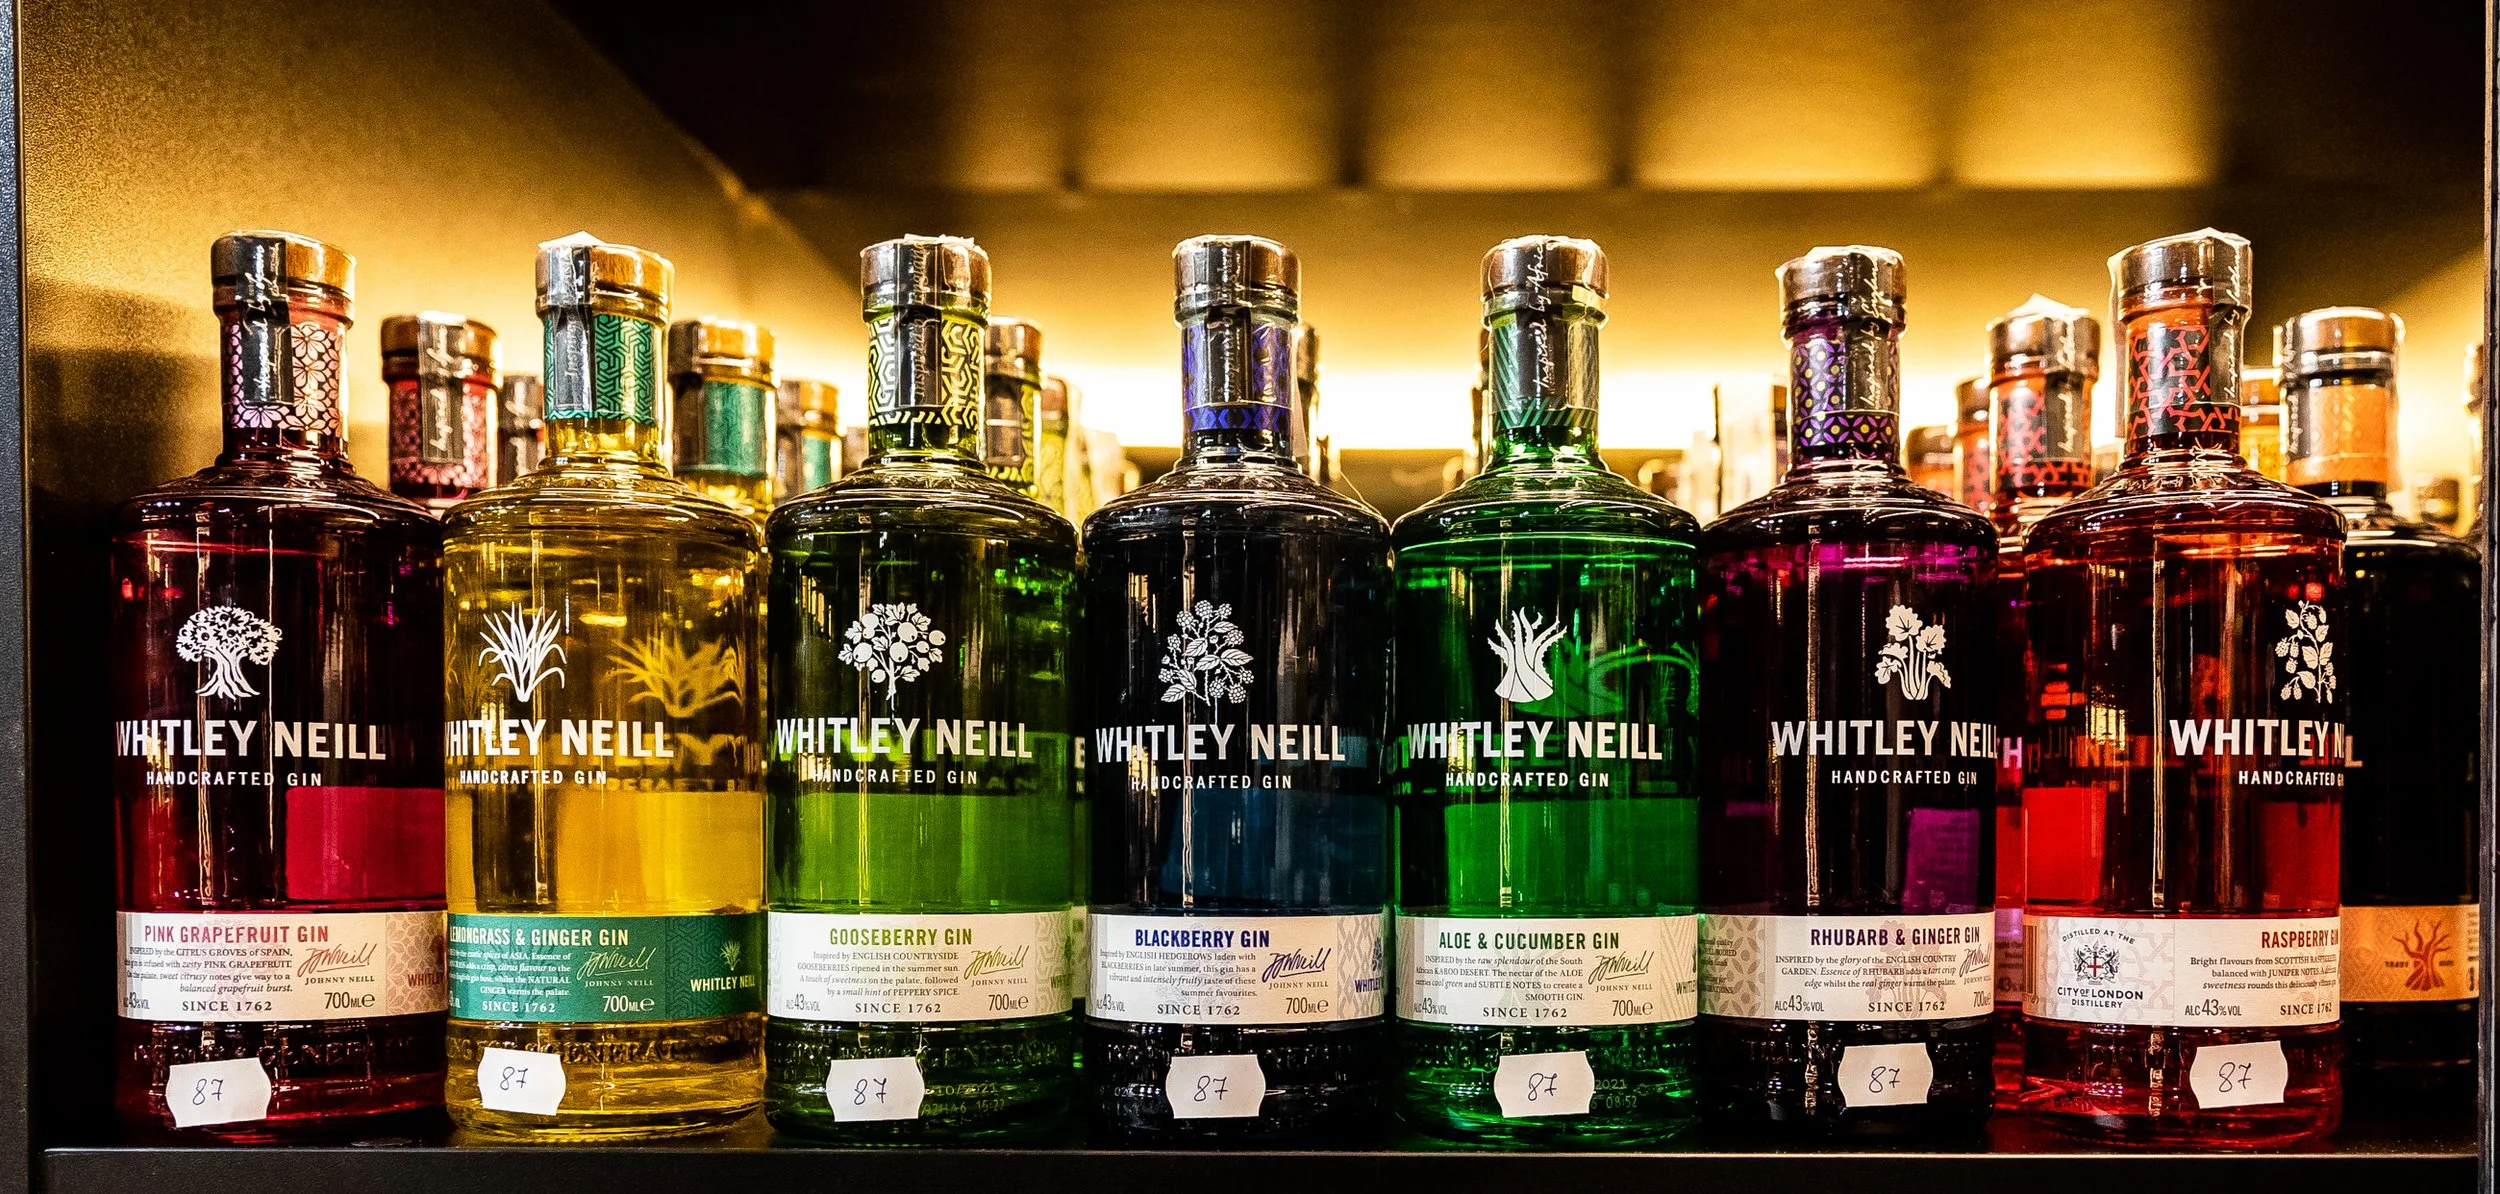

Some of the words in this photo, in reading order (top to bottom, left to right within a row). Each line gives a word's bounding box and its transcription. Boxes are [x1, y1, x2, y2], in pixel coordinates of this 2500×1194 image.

[1529, 295, 1551, 312] by
[1860, 321, 1880, 337] by
[1531, 319, 1554, 388] Inspired
[2224, 330, 2239, 397] Inspired
[1860, 341, 1880, 407] Inspired
[116, 720, 257, 757] WHITLEY
[274, 720, 386, 760] NEILL
[561, 719, 674, 758] NEILL
[777, 718, 920, 754] WHITLEY
[936, 719, 1032, 758] NEILL
[1096, 724, 1236, 763] WHITLEY
[1251, 724, 1346, 761] NEILL
[1407, 721, 1554, 759] WHITLEY
[1568, 721, 1663, 760] NEILL
[1770, 720, 1940, 756] WHITLEY
[2169, 719, 2329, 757] WHITLEY
[146, 771, 274, 787] HANDCRAFTED
[287, 772, 322, 787] GIN
[460, 770, 563, 785] HANDCRAFTED
[574, 770, 607, 784] GIN
[813, 769, 936, 783] HANDCRAFTED
[947, 770, 977, 784] GIN
[1131, 776, 1251, 790] HANDCRAFTED
[1262, 776, 1292, 789] GIN
[1446, 772, 1568, 787] HANDCRAFTED
[1579, 772, 1609, 787] GIN
[1832, 770, 1950, 784] HANDCRAFTED
[1958, 771, 1977, 785] GIN
[2238, 770, 2335, 786] HANDCRAFTED
[145, 925, 174, 943] PINK
[180, 926, 289, 943] GRAPEFRUIT
[298, 926, 328, 942] GIN
[450, 926, 510, 945] LEMONGRASS
[516, 929, 525, 945] &
[532, 929, 592, 946] GINGER
[600, 929, 628, 946] GIN
[830, 928, 937, 945] GOOSEBERRY
[945, 928, 972, 945] GIN
[1135, 929, 1234, 948] BLACKBERRY
[1241, 930, 1270, 948] GIN
[1439, 932, 1471, 949] ALOE
[1478, 933, 1488, 949] &
[1495, 933, 1585, 949] CUCUMBER
[1593, 933, 1619, 949] GIN
[1811, 929, 1888, 945] RHUBARB
[1895, 929, 1905, 945] &
[1912, 928, 1960, 945] GINGER
[1965, 927, 1980, 943] GIN
[2062, 928, 2100, 942] DISTILLED
[2118, 933, 2135, 944] THE
[2262, 929, 2328, 948] RASPBERRY
[813, 952, 840, 961] Inspired
[842, 952, 850, 962] by
[852, 952, 891, 960] ENGLISH
[893, 952, 959, 960] COUNTRYSIDE
[1425, 955, 1454, 963] INSPIRED
[1456, 957, 1463, 966] by
[1494, 957, 1534, 967] splendour
[1536, 957, 1545, 965] of
[1560, 957, 1583, 965] South
[1815, 956, 1825, 964] by
[1840, 956, 1861, 966] glory
[1862, 956, 1870, 964] of
[1872, 956, 1884, 964] the
[1922, 955, 1956, 963] COUNTRY
[2190, 957, 2217, 967] Bright
[2220, 957, 2253, 965] flavours
[2275, 956, 2309, 964] SCOTTISH
[798, 962, 850, 971] GOOSEBERRIES
[851, 965, 880, 974] ripened
[305, 977, 345, 985] JOHNNY
[584, 980, 622, 988] JOHNNY
[690, 977, 738, 992] WHITLEY
[739, 975, 755, 988] NEILL
[971, 979, 1005, 987] JOHNNY
[1269, 982, 1303, 990] JOHNNY
[180, 984, 216, 993] balanced
[218, 984, 264, 995] grapefruit
[266, 984, 293, 992] burst.
[480, 986, 506, 994] GINGER
[545, 988, 570, 997] palate.
[1215, 989, 1258, 997] favourites.
[1525, 993, 1564, 1001] SMOOTH
[1566, 993, 1584, 1001] GIN.
[2057, 987, 2080, 995] CITY
[2080, 989, 2090, 997] OF
[2092, 990, 2143, 1000] LONDON
[182, 1001, 228, 1011] SINCE
[236, 1001, 272, 1011] 1762
[482, 1001, 519, 1012] SINCE
[525, 1003, 555, 1012] 1762
[855, 1003, 900, 1013] SINCE
[908, 1003, 941, 1013] 1762
[1158, 1004, 1200, 1015] SINCE
[1208, 1005, 1240, 1015] 1762
[1868, 1002, 1912, 1013] SINCE
[1919, 1001, 1945, 1012] 1762
[2071, 999, 2123, 1008] DISTILLERY
[2280, 1003, 2313, 1016] SINCE
[2317, 1002, 2332, 1014] 1762
[1483, 1007, 1527, 1018] SINCE
[1535, 1008, 1567, 1018] 1762
[499, 1066, 528, 1091] 87
[1869, 1066, 1900, 1093] 87
[2218, 1061, 2252, 1093] 87
[192, 1078, 224, 1105] 87
[854, 1078, 887, 1106] 87
[1194, 1075, 1228, 1102] 87
[1528, 1072, 1558, 1101] 87
